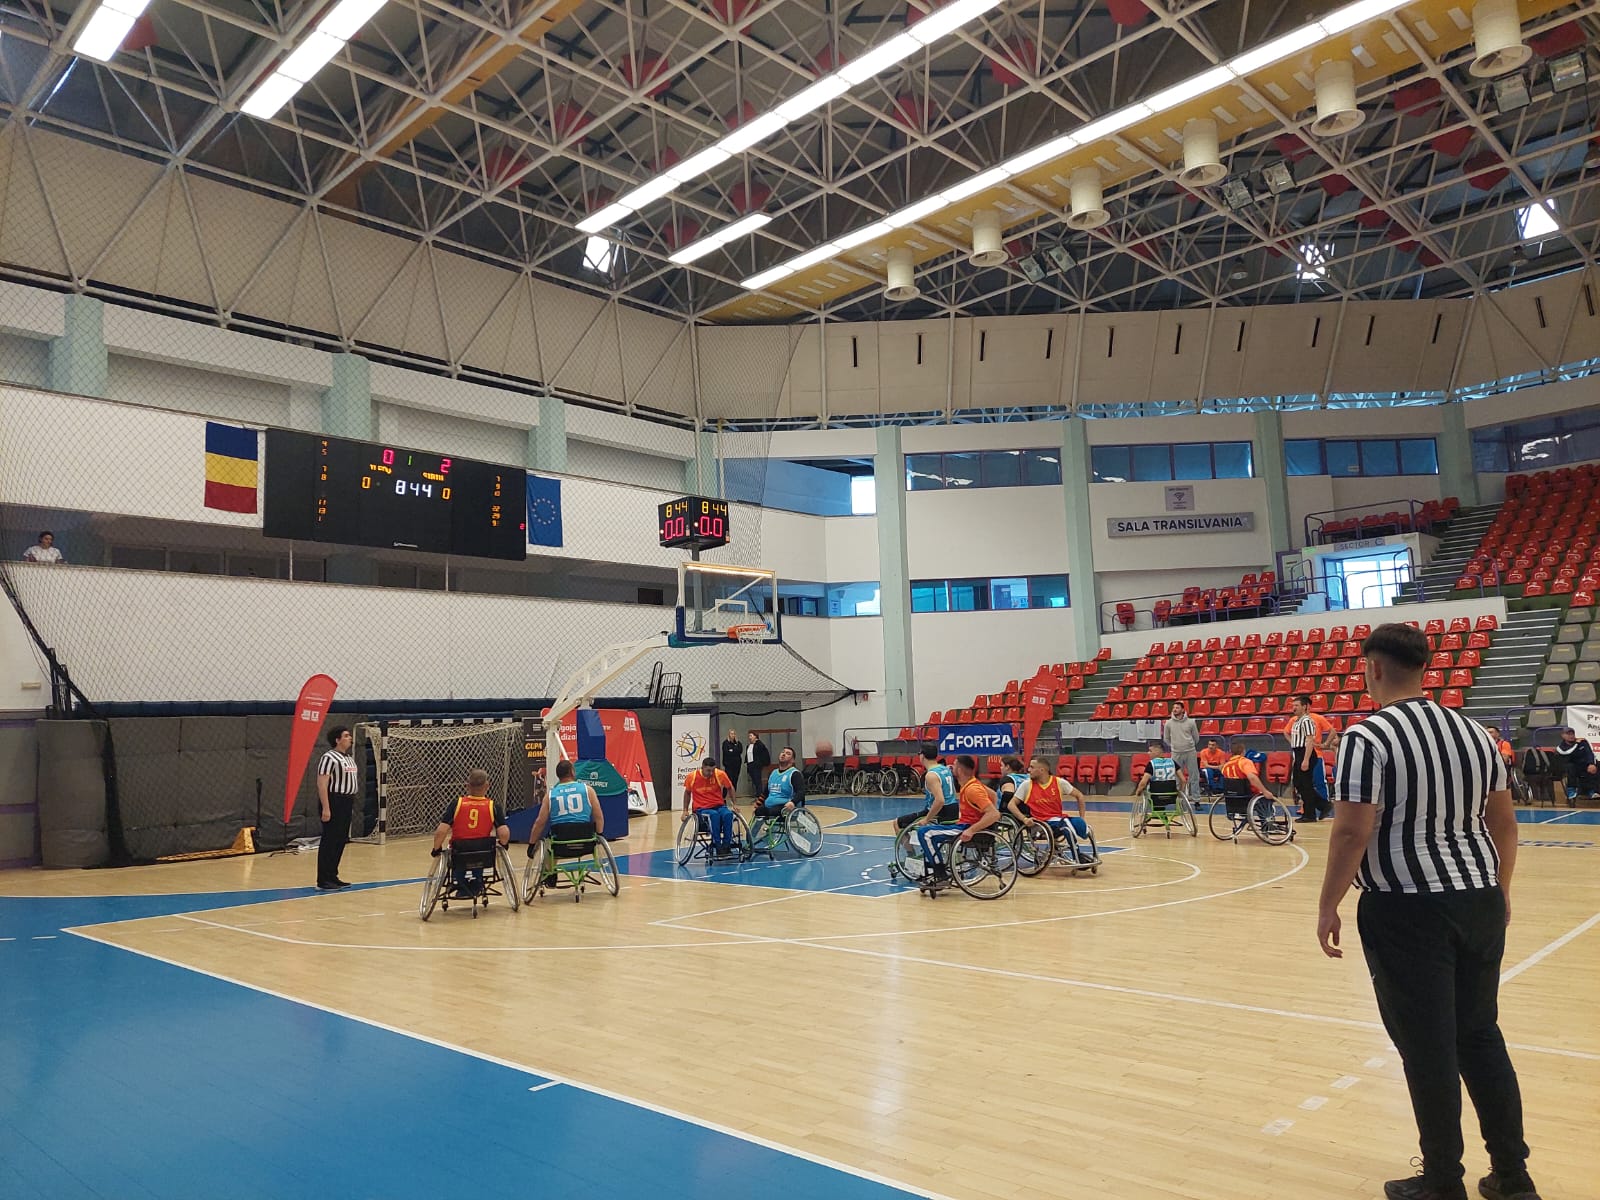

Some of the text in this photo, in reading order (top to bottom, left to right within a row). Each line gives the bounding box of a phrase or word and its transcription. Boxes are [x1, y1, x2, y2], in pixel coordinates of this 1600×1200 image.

[383, 449, 394, 464] 0
[440, 459, 451, 473] 2
[361, 476, 371, 489] 0
[441, 487, 451, 500] 0
[701, 516, 722, 537] 0.0
[1118, 517, 1242, 532] SALA TRANSILVANIA
[956, 734, 1013, 748] FORTZA
[556, 793, 583, 816] 10
[468, 809, 479, 829] 9
